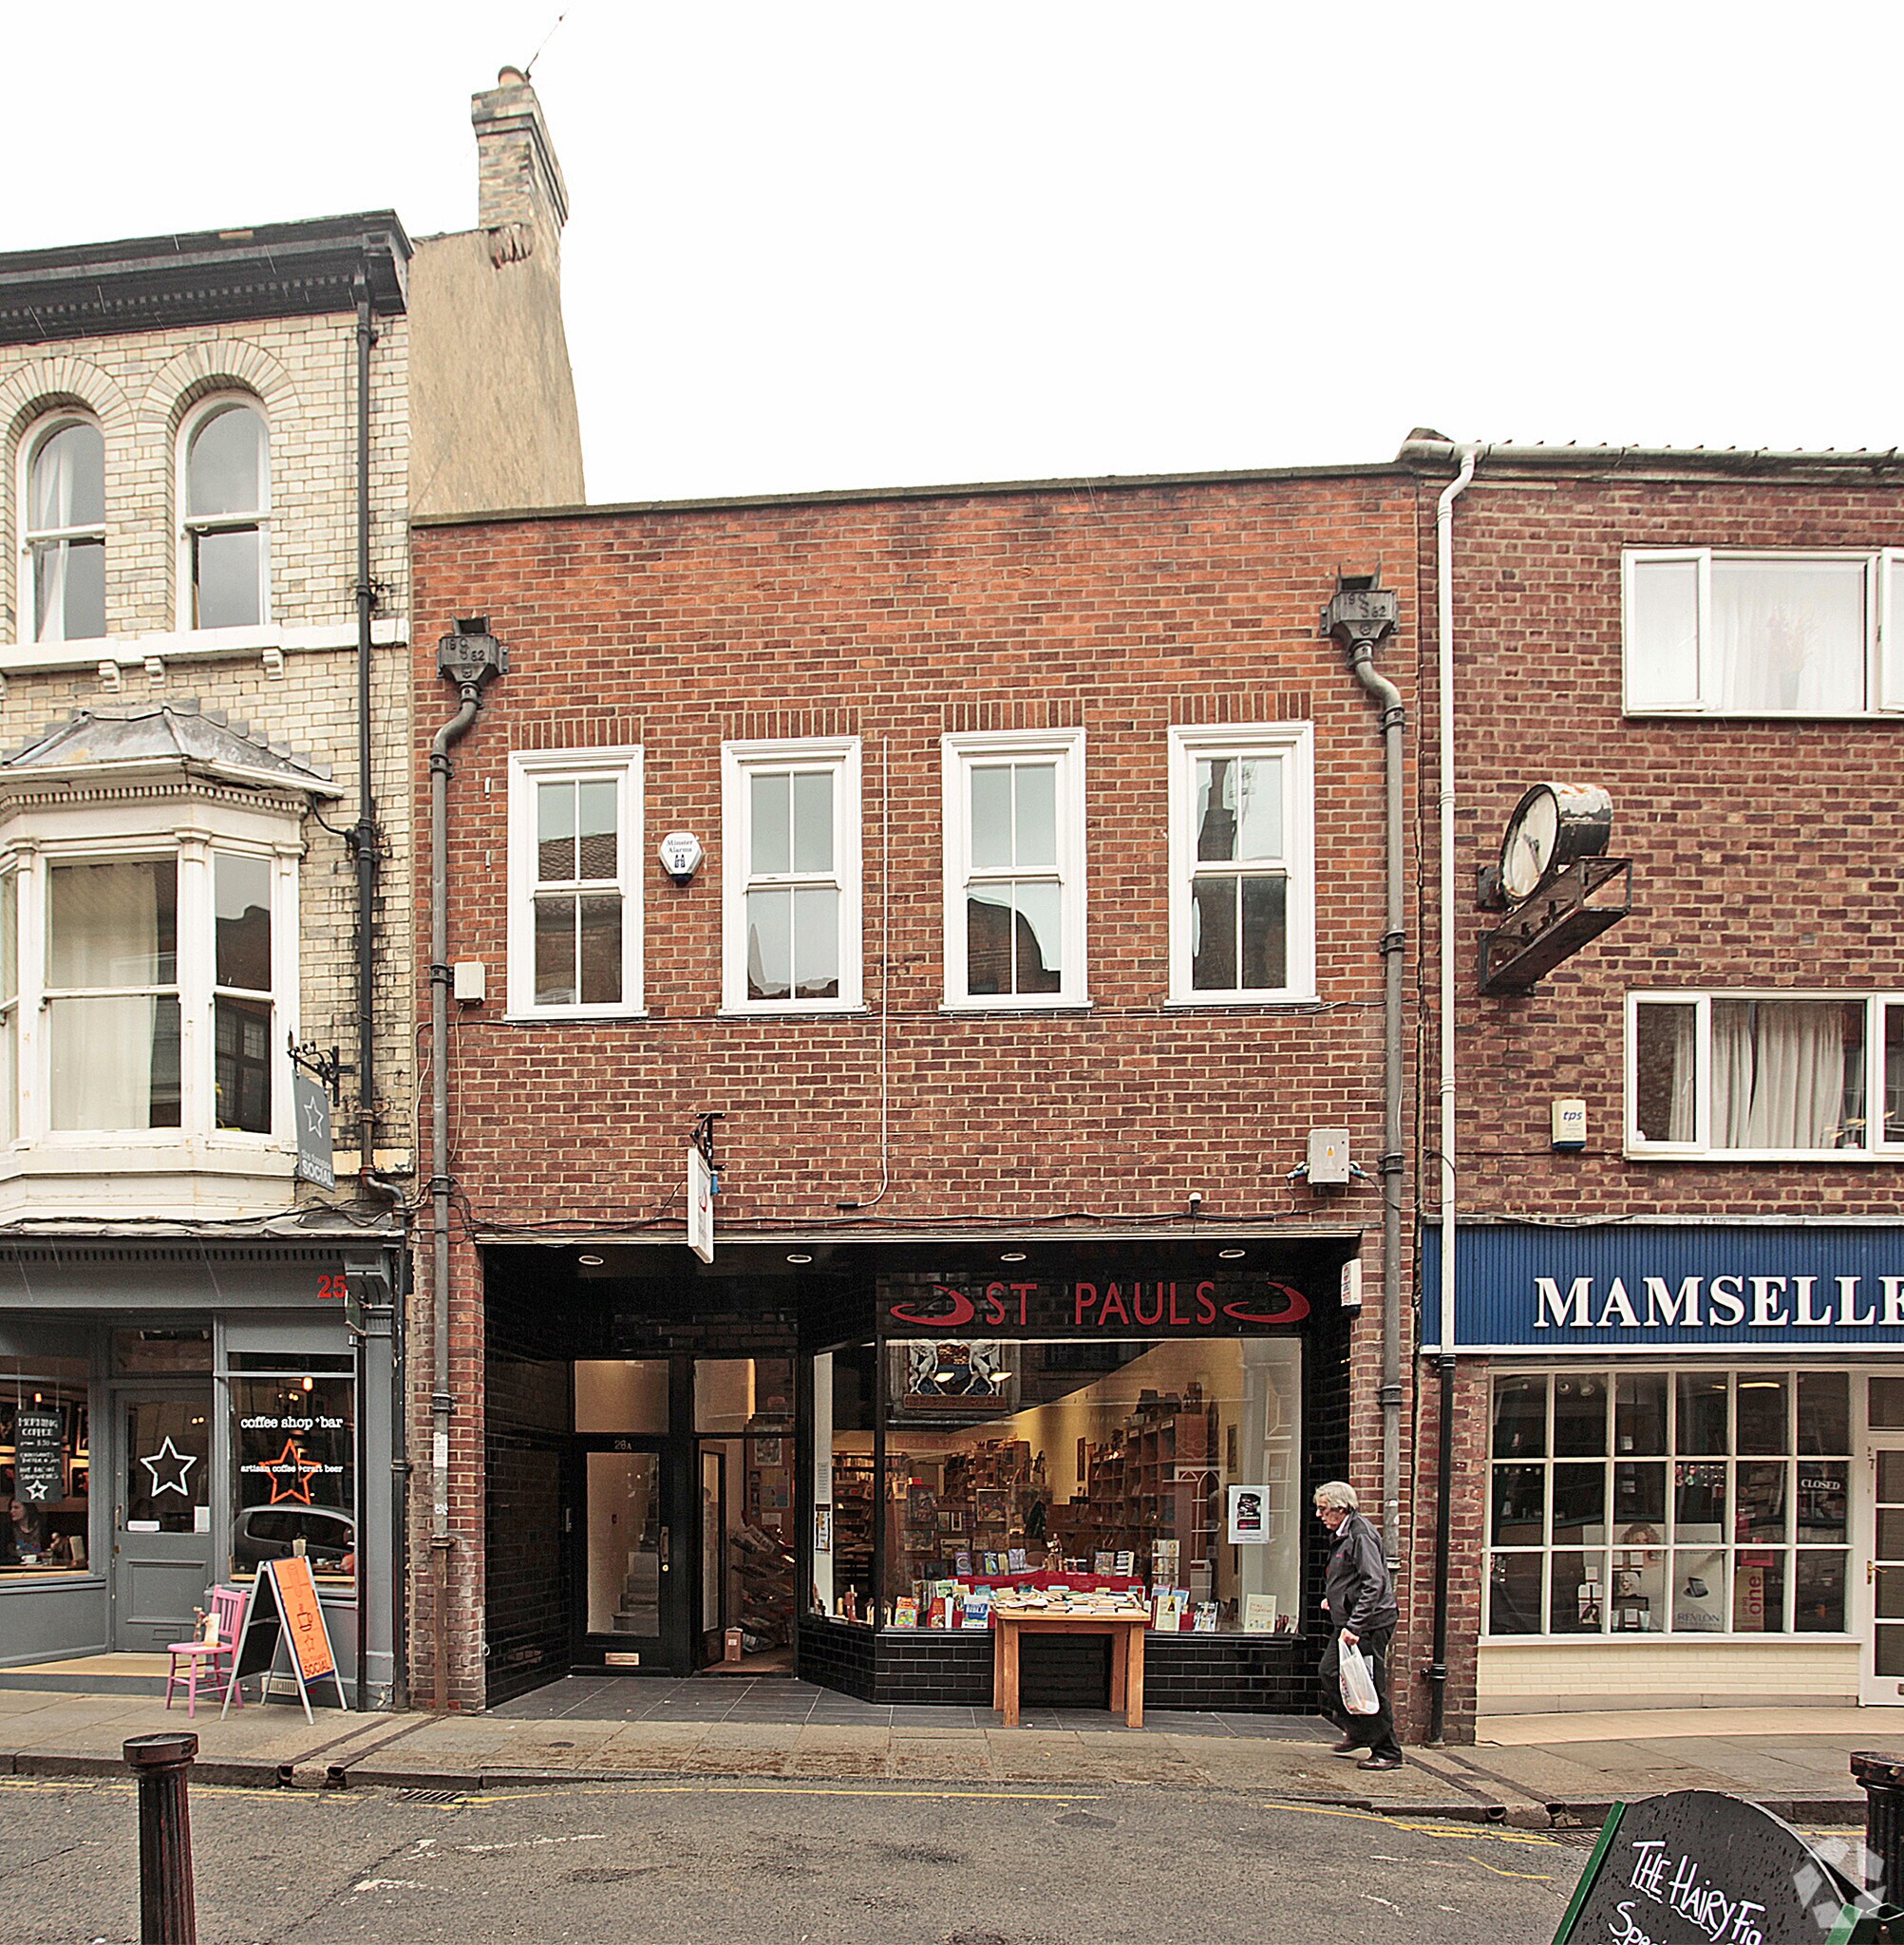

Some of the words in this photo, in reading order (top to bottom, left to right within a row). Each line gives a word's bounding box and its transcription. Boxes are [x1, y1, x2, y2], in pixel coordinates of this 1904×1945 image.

[1563, 1111, 1583, 1122] tps
[301, 1159, 333, 1187] SOCIAL
[316, 1275, 348, 1298] 25
[985, 1281, 1037, 1326] ST
[1075, 1280, 1216, 1326] PAULS
[240, 1416, 278, 1428] coffee
[281, 1416, 313, 1430] shop
[272, 1464, 296, 1473] coffee
[324, 1464, 344, 1473] beer
[1800, 1479, 1840, 1490] CLOSED
[1749, 1576, 1763, 1615] one
[1677, 1613, 1721, 1622] REVLON
